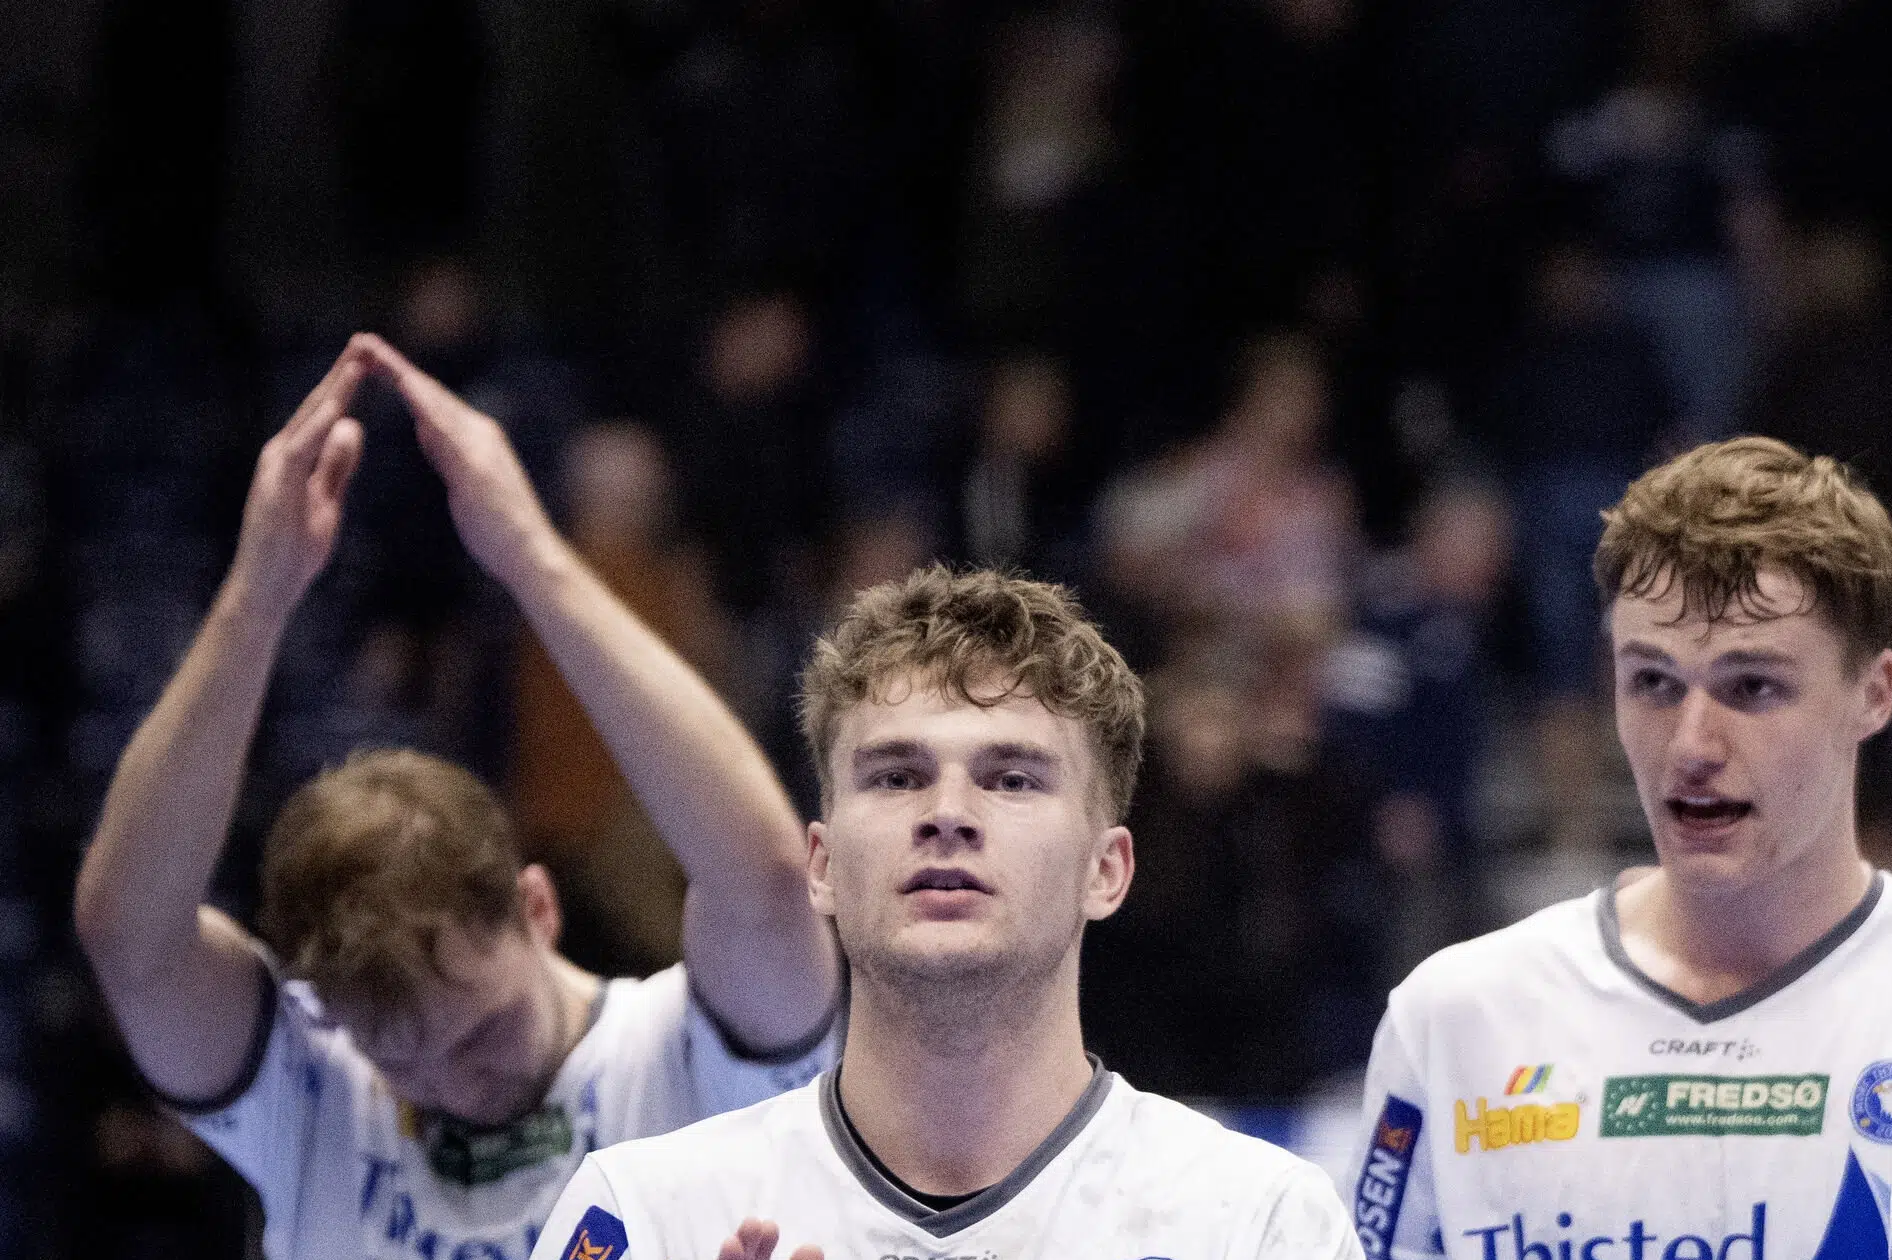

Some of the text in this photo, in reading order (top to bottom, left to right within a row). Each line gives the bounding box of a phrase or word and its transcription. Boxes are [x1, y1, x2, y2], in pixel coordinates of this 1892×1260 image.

[1649, 1038, 1734, 1057] CRAFT
[1665, 1079, 1824, 1112] FREDSØ
[1454, 1097, 1580, 1154] Hama
